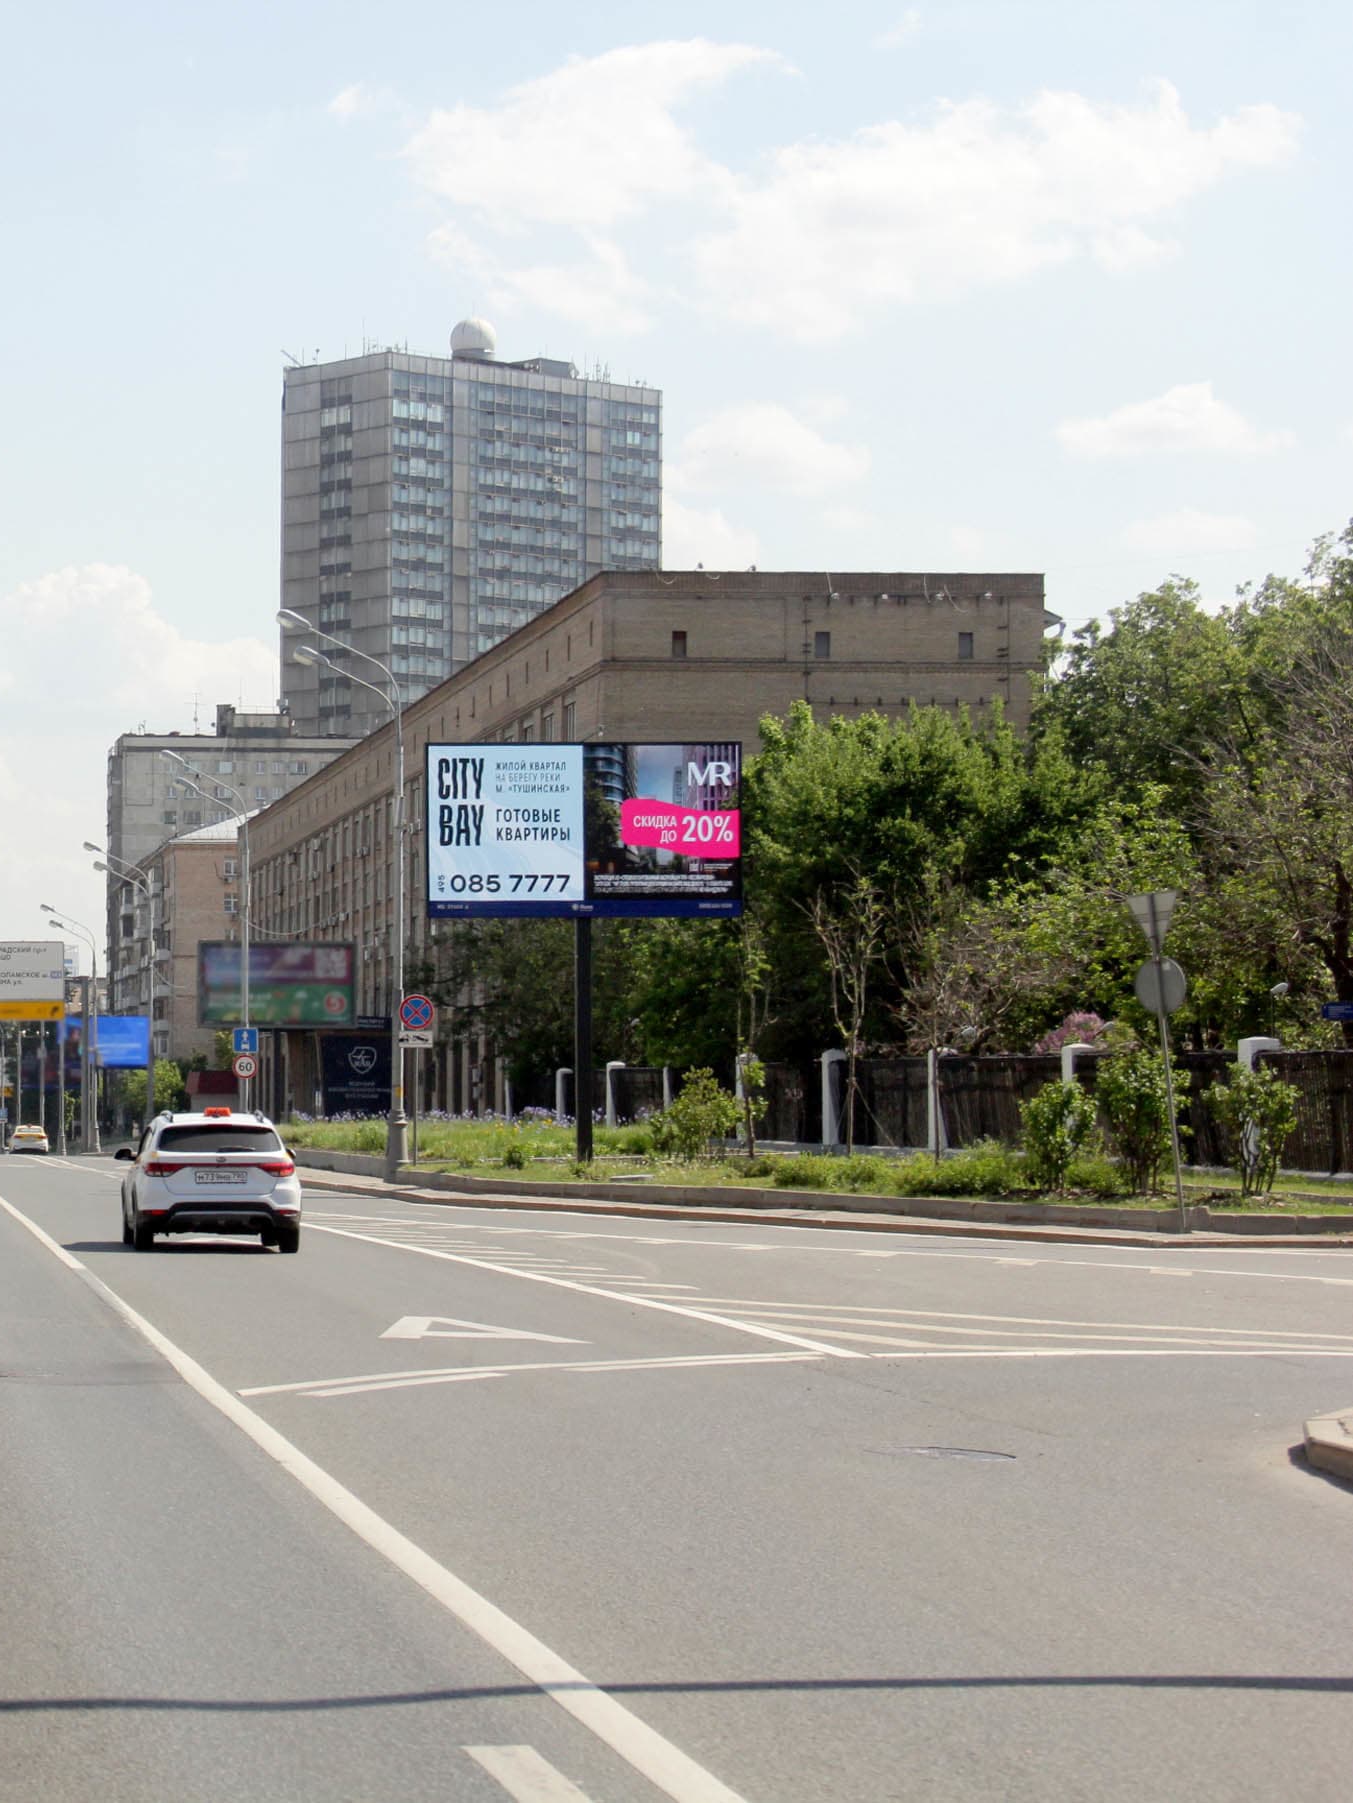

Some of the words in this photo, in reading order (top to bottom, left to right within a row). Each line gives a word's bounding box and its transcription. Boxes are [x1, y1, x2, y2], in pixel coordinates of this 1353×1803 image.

[496, 760, 526, 771] ЖИЛОЙ
[529, 761, 567, 771] КВАРТАЛ
[438, 758, 484, 799] CITY
[496, 773, 506, 783] НА
[508, 772, 538, 783] БЕРЕГУ
[540, 772, 561, 782] РЕКИ
[688, 761, 732, 786] MR
[508, 784, 570, 794] «ТУШИНСКАЯ»
[496, 809, 561, 823] ГОТОВЫЕ
[633, 815, 678, 829] СКИДКА
[439, 805, 484, 846] BAY
[681, 815, 734, 843] 20%
[496, 827, 570, 841] КВАРТИРЫ
[660, 830, 678, 844] ДО
[450, 874, 501, 893] 085
[509, 874, 571, 893] 7777
[238, 1062, 253, 1072] 60
